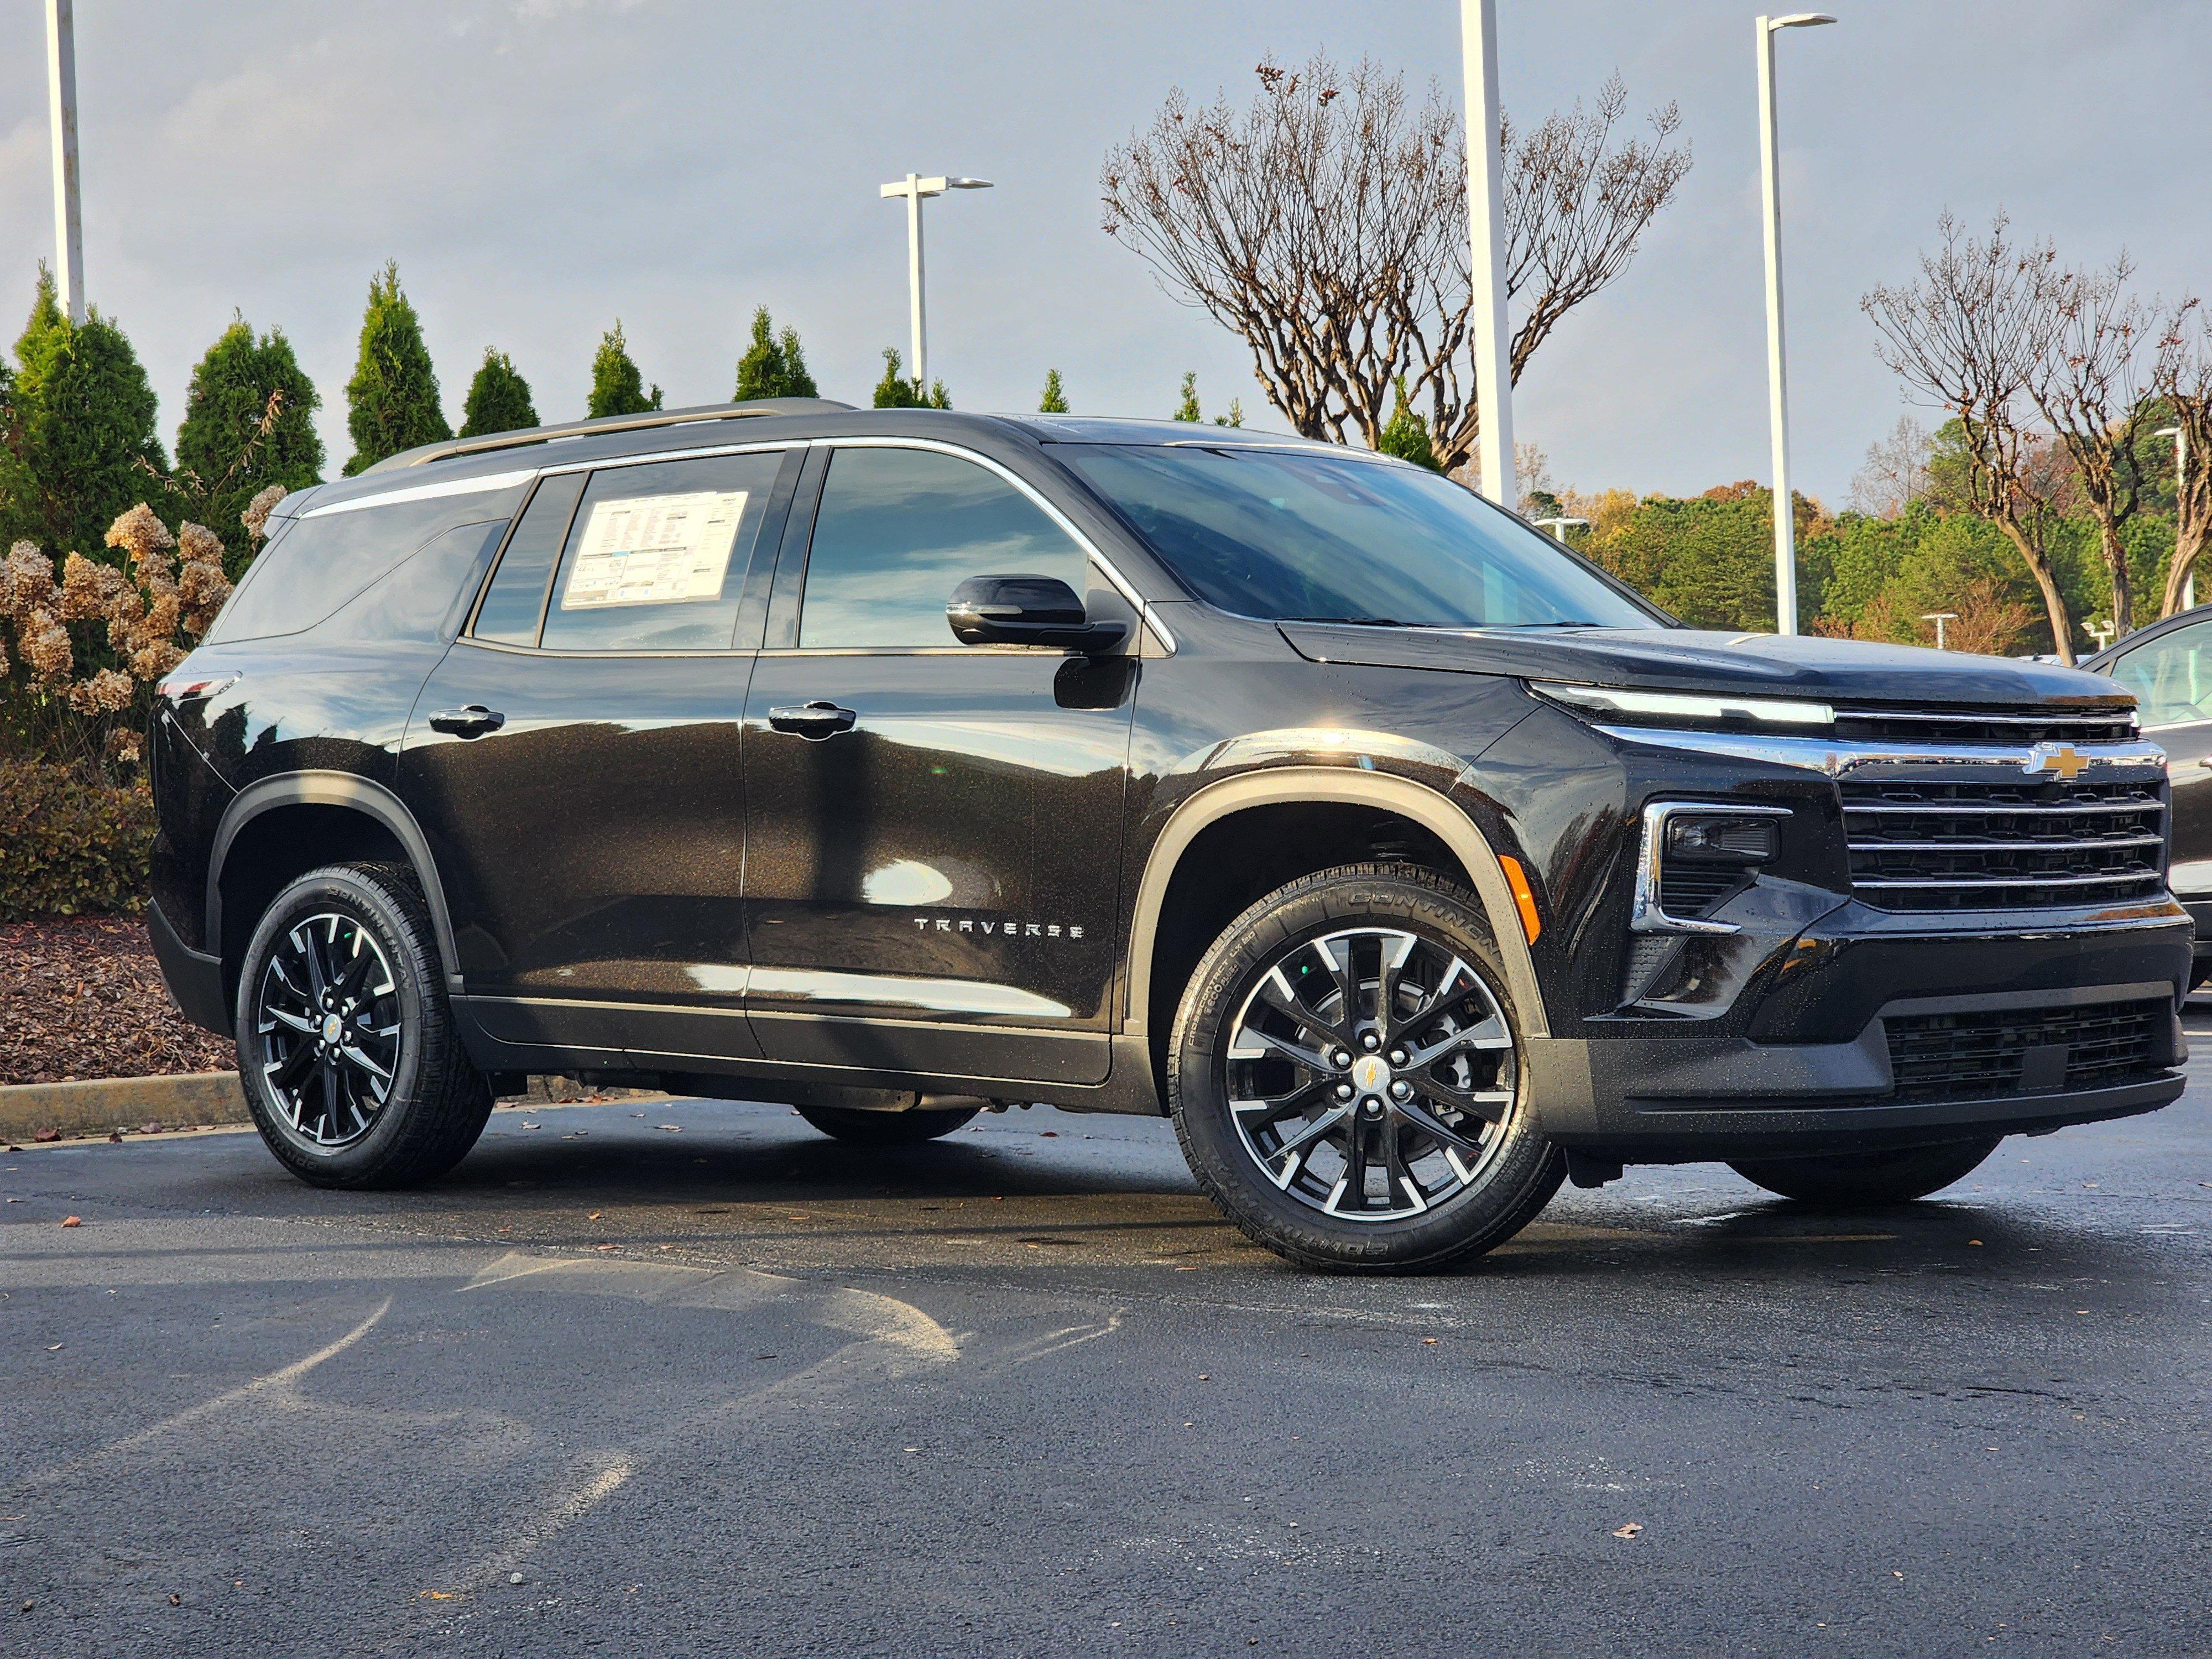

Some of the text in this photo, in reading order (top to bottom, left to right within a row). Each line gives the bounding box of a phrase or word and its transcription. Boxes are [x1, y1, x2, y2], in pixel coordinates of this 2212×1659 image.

[914, 918, 1084, 939] TRAVERSE
[1348, 893, 1500, 955] CONTINEN
[1229, 943, 1243, 958] LX
